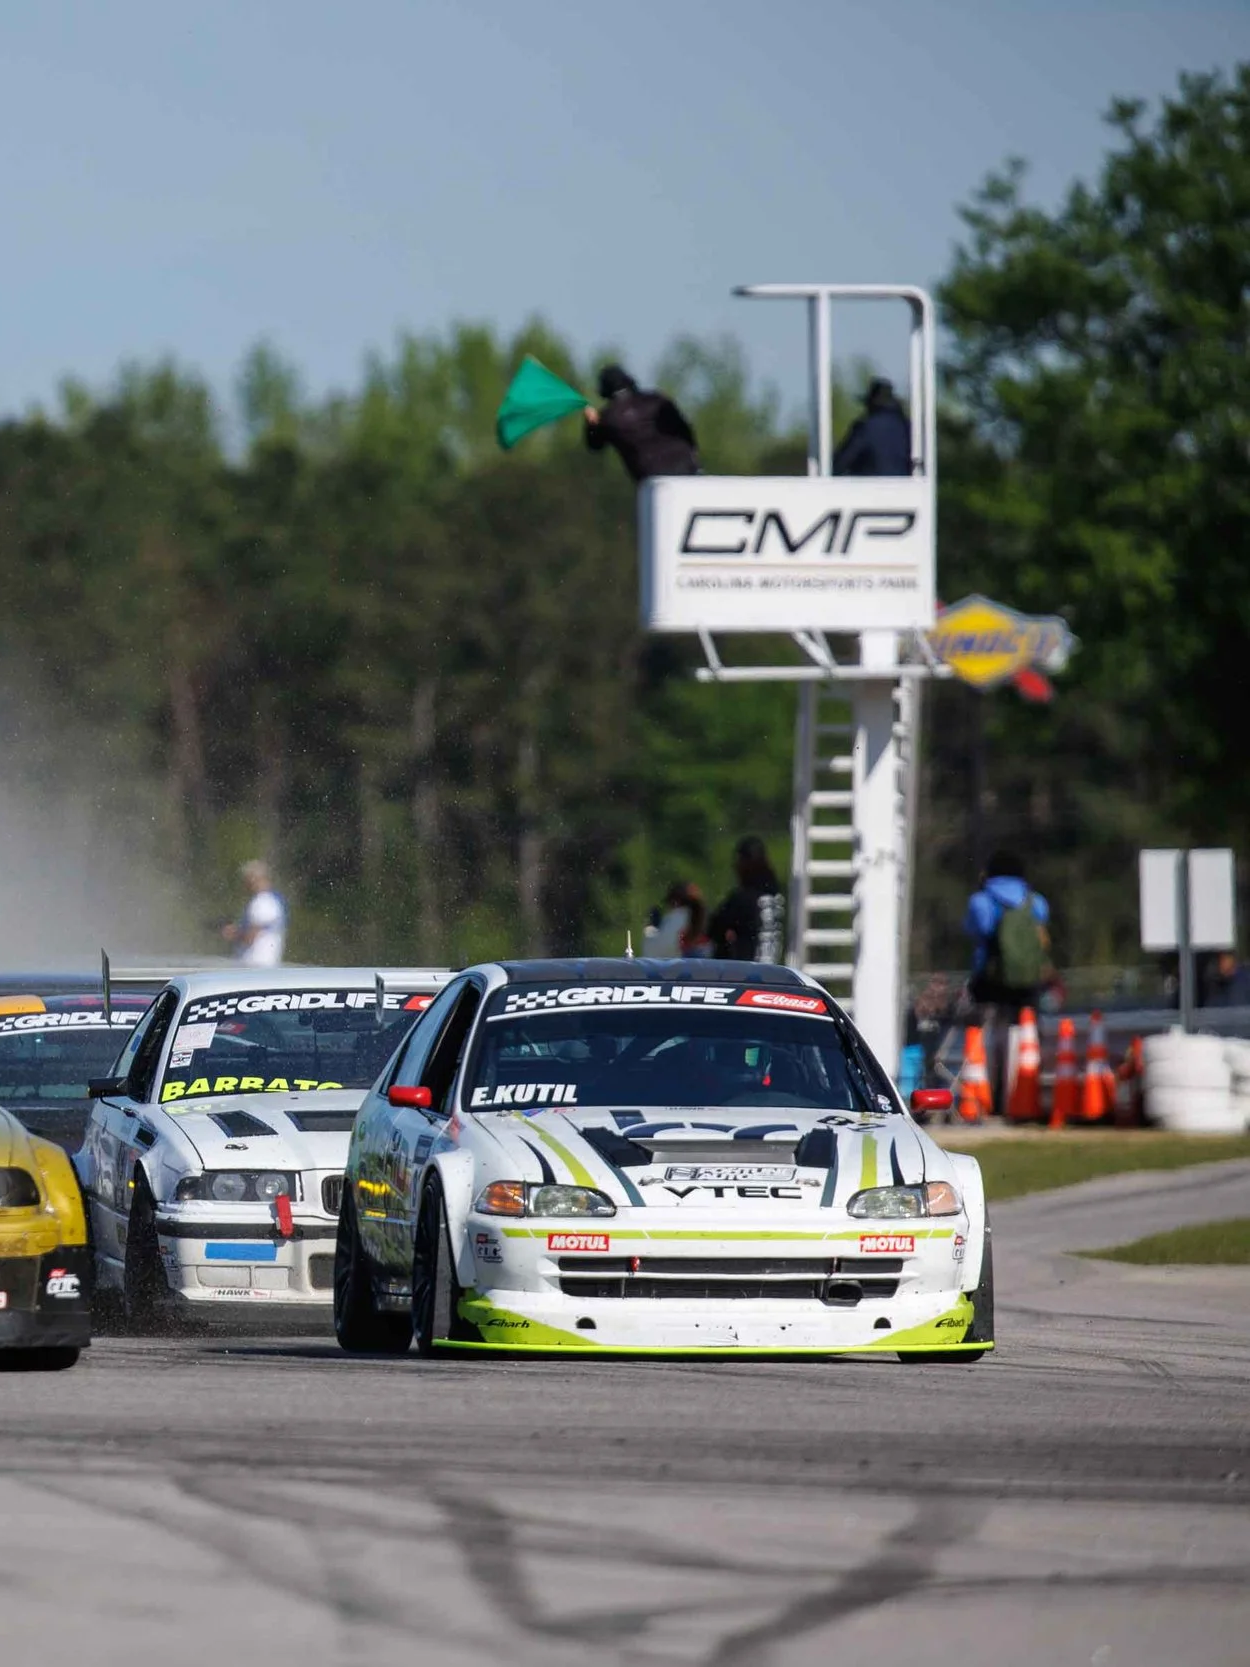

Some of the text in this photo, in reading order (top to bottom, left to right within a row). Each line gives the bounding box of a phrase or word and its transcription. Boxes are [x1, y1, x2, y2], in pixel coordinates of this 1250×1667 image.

[680, 509, 917, 553] CMP
[237, 993, 409, 1012] GRIDLIFE
[557, 986, 737, 1004] GRIDLIFE
[470, 1084, 578, 1107] E.KUTIL
[662, 1186, 802, 1199] VTEC
[551, 1236, 607, 1250] MOTUL
[862, 1238, 914, 1251] MOTUL
